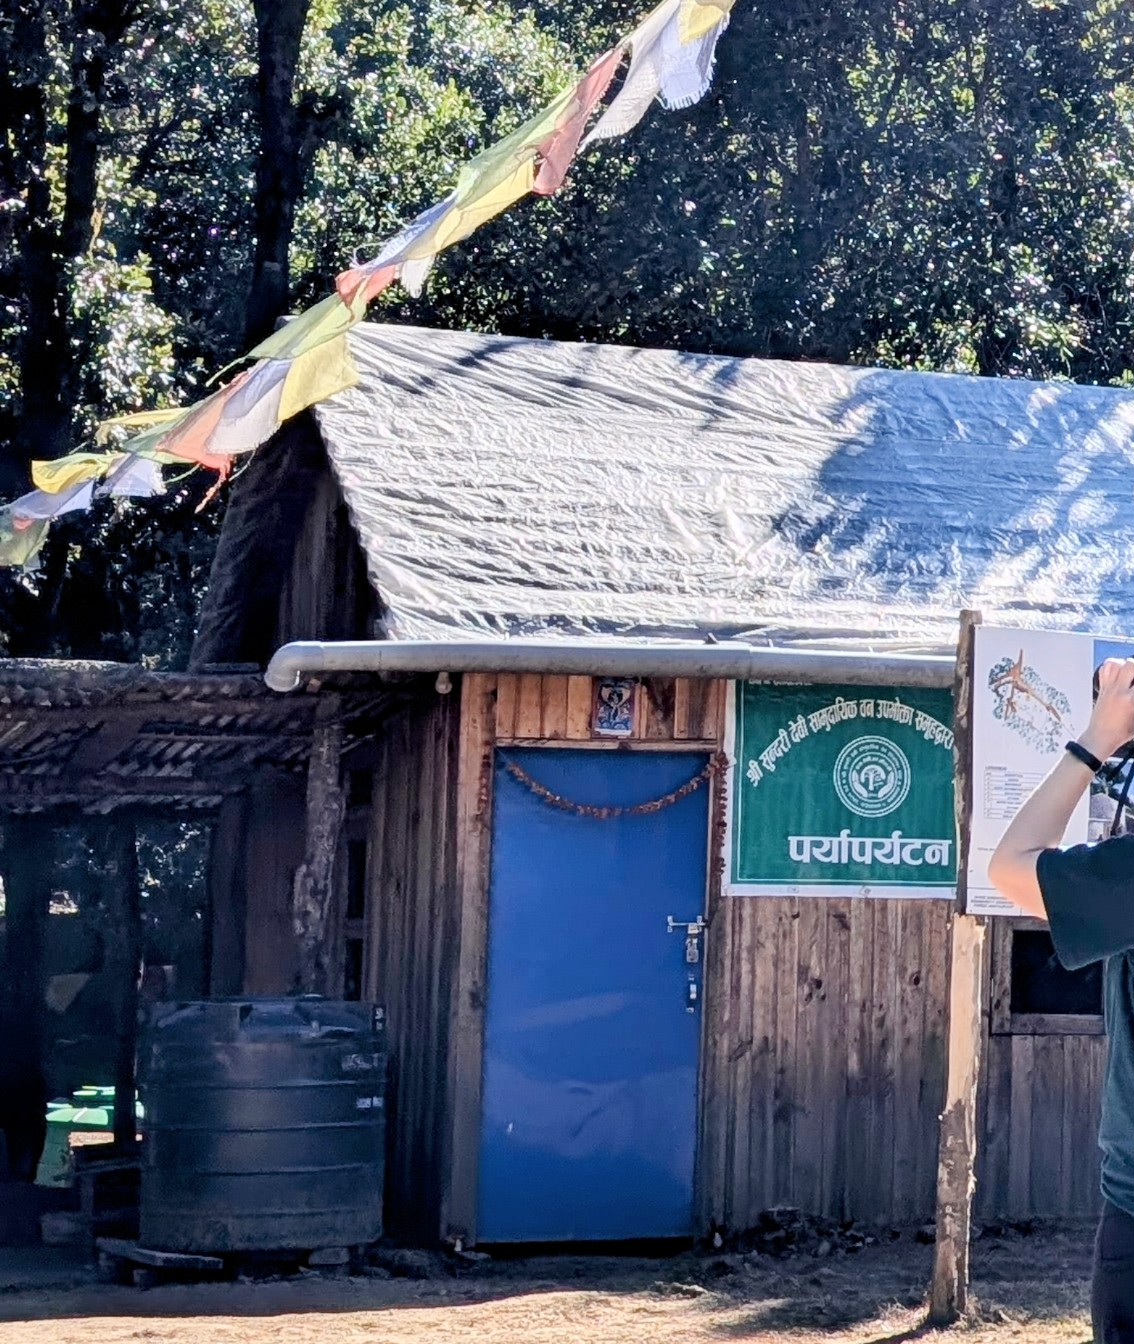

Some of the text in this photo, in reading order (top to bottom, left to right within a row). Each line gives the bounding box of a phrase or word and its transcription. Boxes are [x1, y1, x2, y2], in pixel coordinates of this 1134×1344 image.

[746, 759, 763, 787] श्री
[758, 728, 791, 772] सुन्दरी
[788, 714, 809, 743] देवी
[807, 696, 858, 733] सामुदायिक
[859, 699, 875, 718] वन
[787, 829, 952, 866] पर्यापर्यटन
